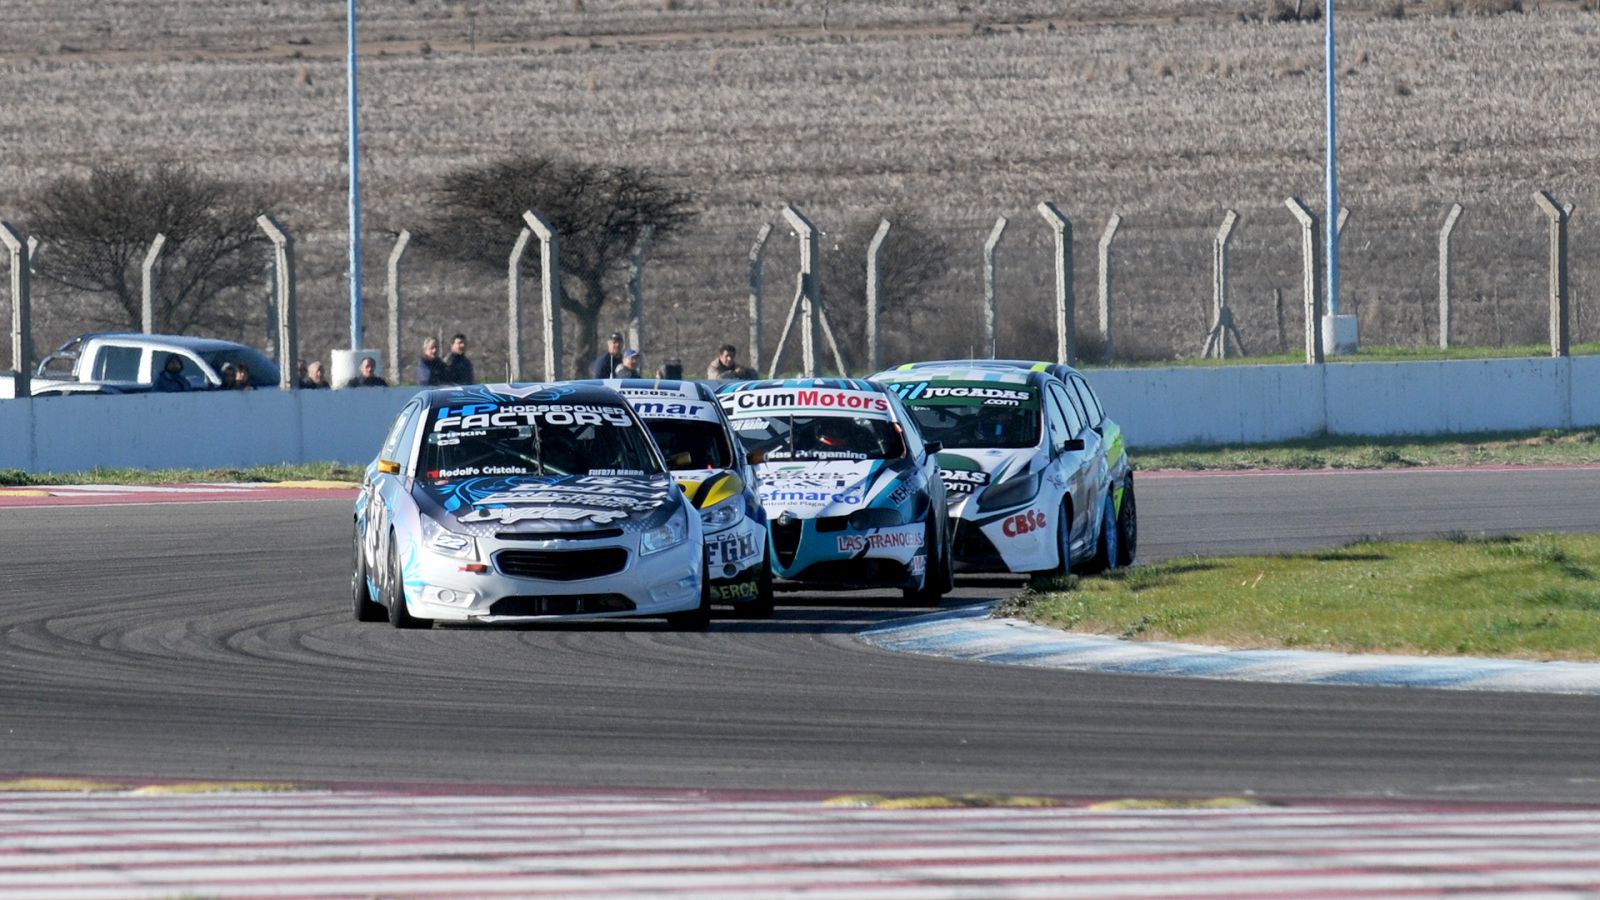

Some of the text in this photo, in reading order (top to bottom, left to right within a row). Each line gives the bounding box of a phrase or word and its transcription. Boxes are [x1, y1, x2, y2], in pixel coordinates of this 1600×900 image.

[738, 391, 888, 411] CumMotors
[923, 388, 1030, 400] JUGADAS
[984, 398, 1019, 406] .com
[437, 403, 626, 419] HP HORSEPOWER
[433, 411, 633, 432] FACTORY
[439, 466, 527, 478] Rodolfo Cristales
[838, 536, 863, 551] LAS
